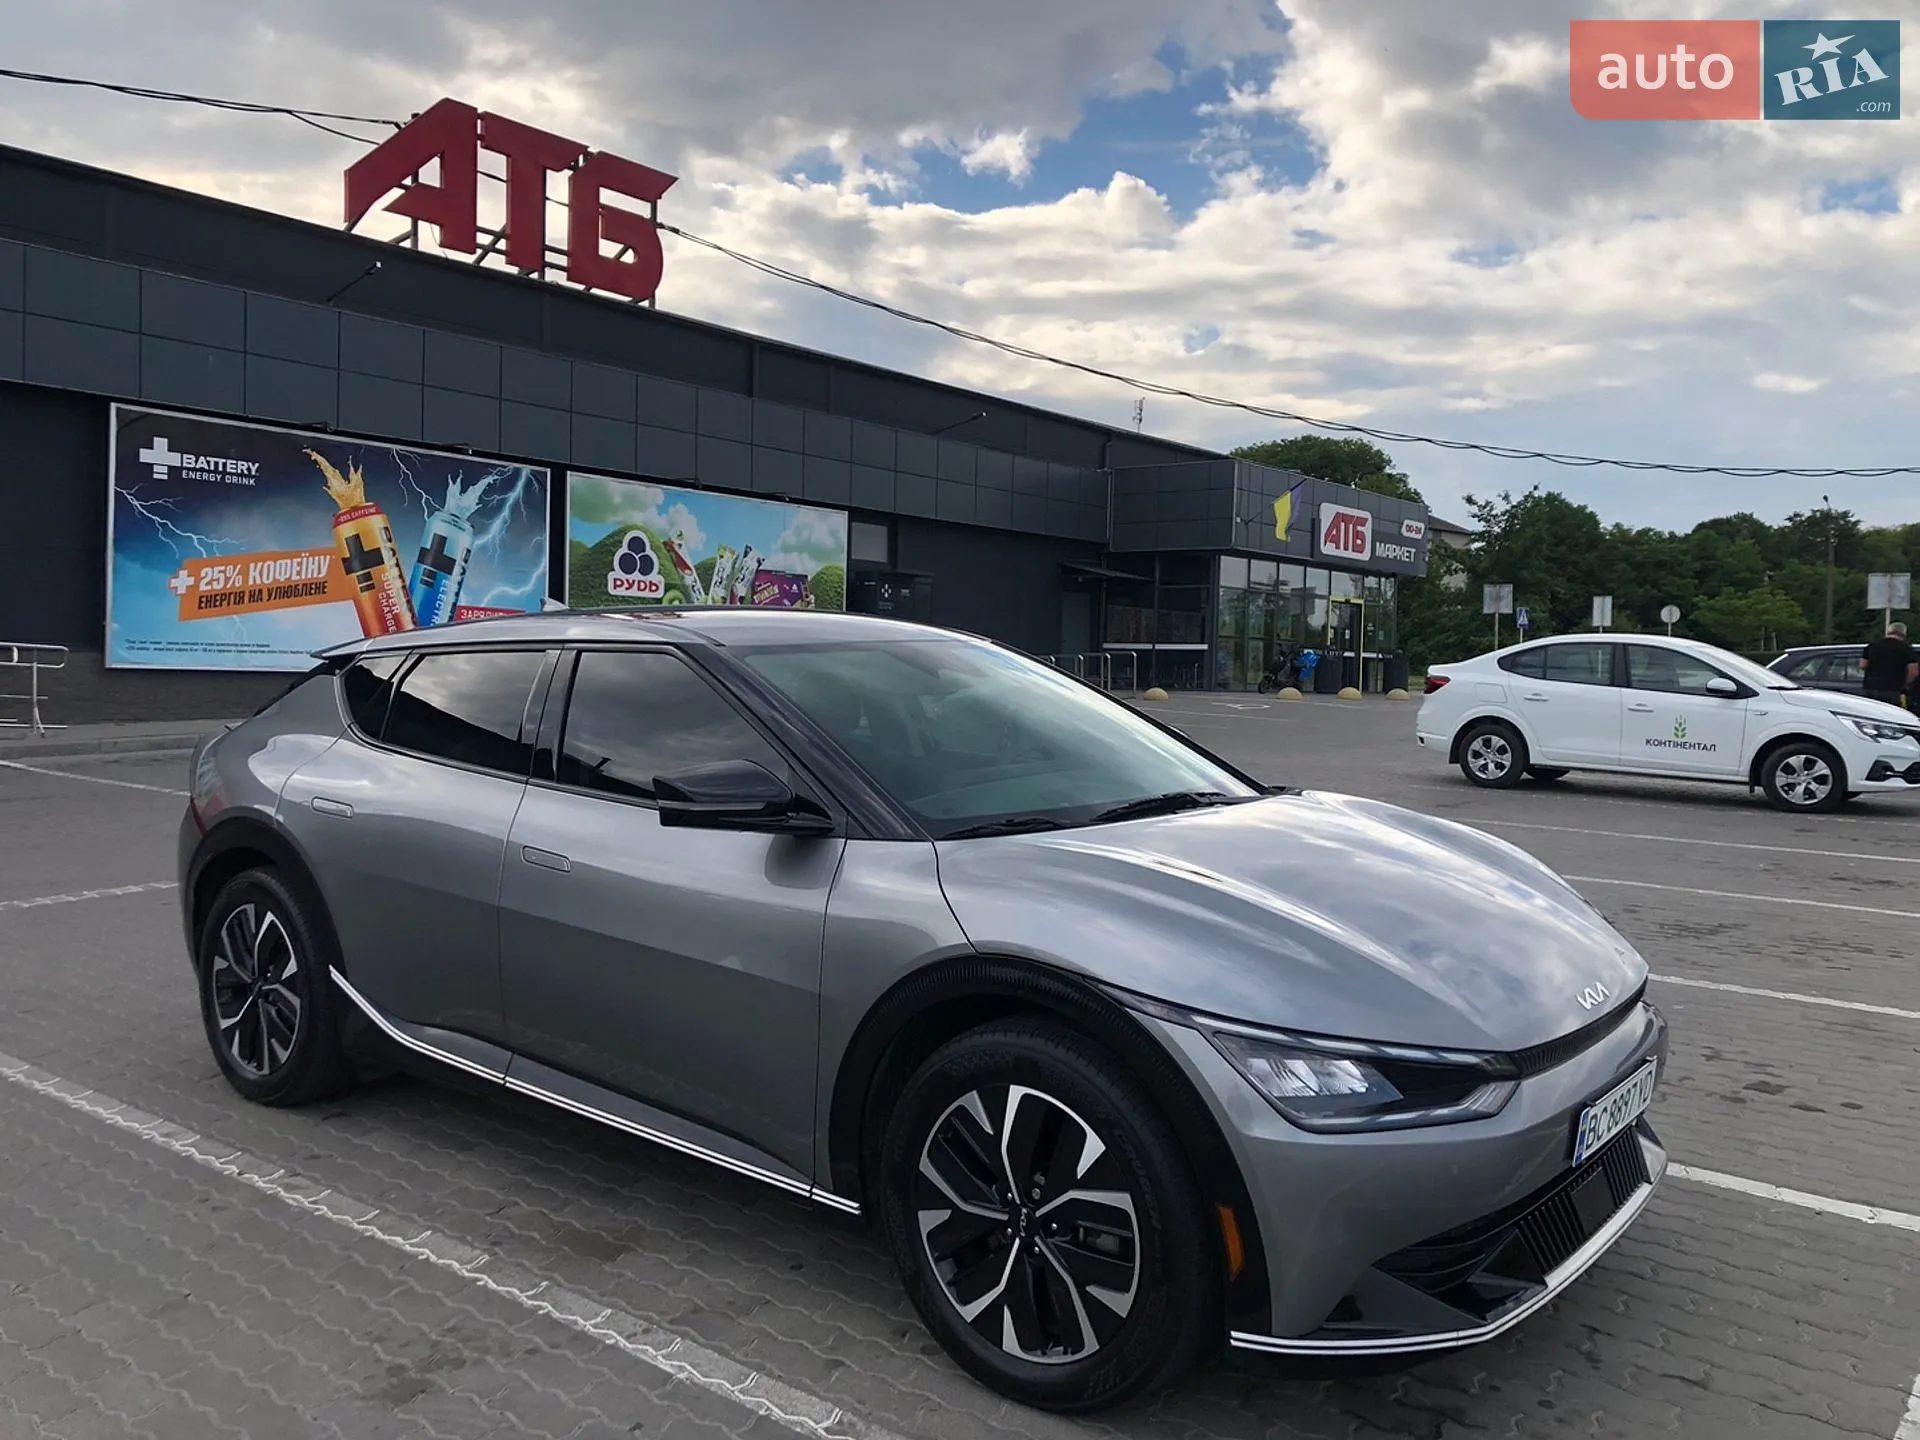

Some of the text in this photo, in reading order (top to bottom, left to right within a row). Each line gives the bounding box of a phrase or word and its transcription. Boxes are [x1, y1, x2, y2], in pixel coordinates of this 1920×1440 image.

[344, 97, 680, 301] АТБ
[182, 453, 260, 476] BATTERY
[182, 469, 256, 486] ENERGY DRINK
[1324, 511, 1369, 554] АТБ
[1375, 542, 1416, 562] МАРКЕТ
[248, 553, 331, 585] КОФЕЇНУ
[197, 581, 328, 610] ЕНЕРГІЯ НА УЛЮБЛЕНЕ
[381, 573, 401, 615] SUPER
[613, 578, 660, 593] РУДЬ
[1645, 739, 1716, 751] КОНТІНЕНТАЛ
